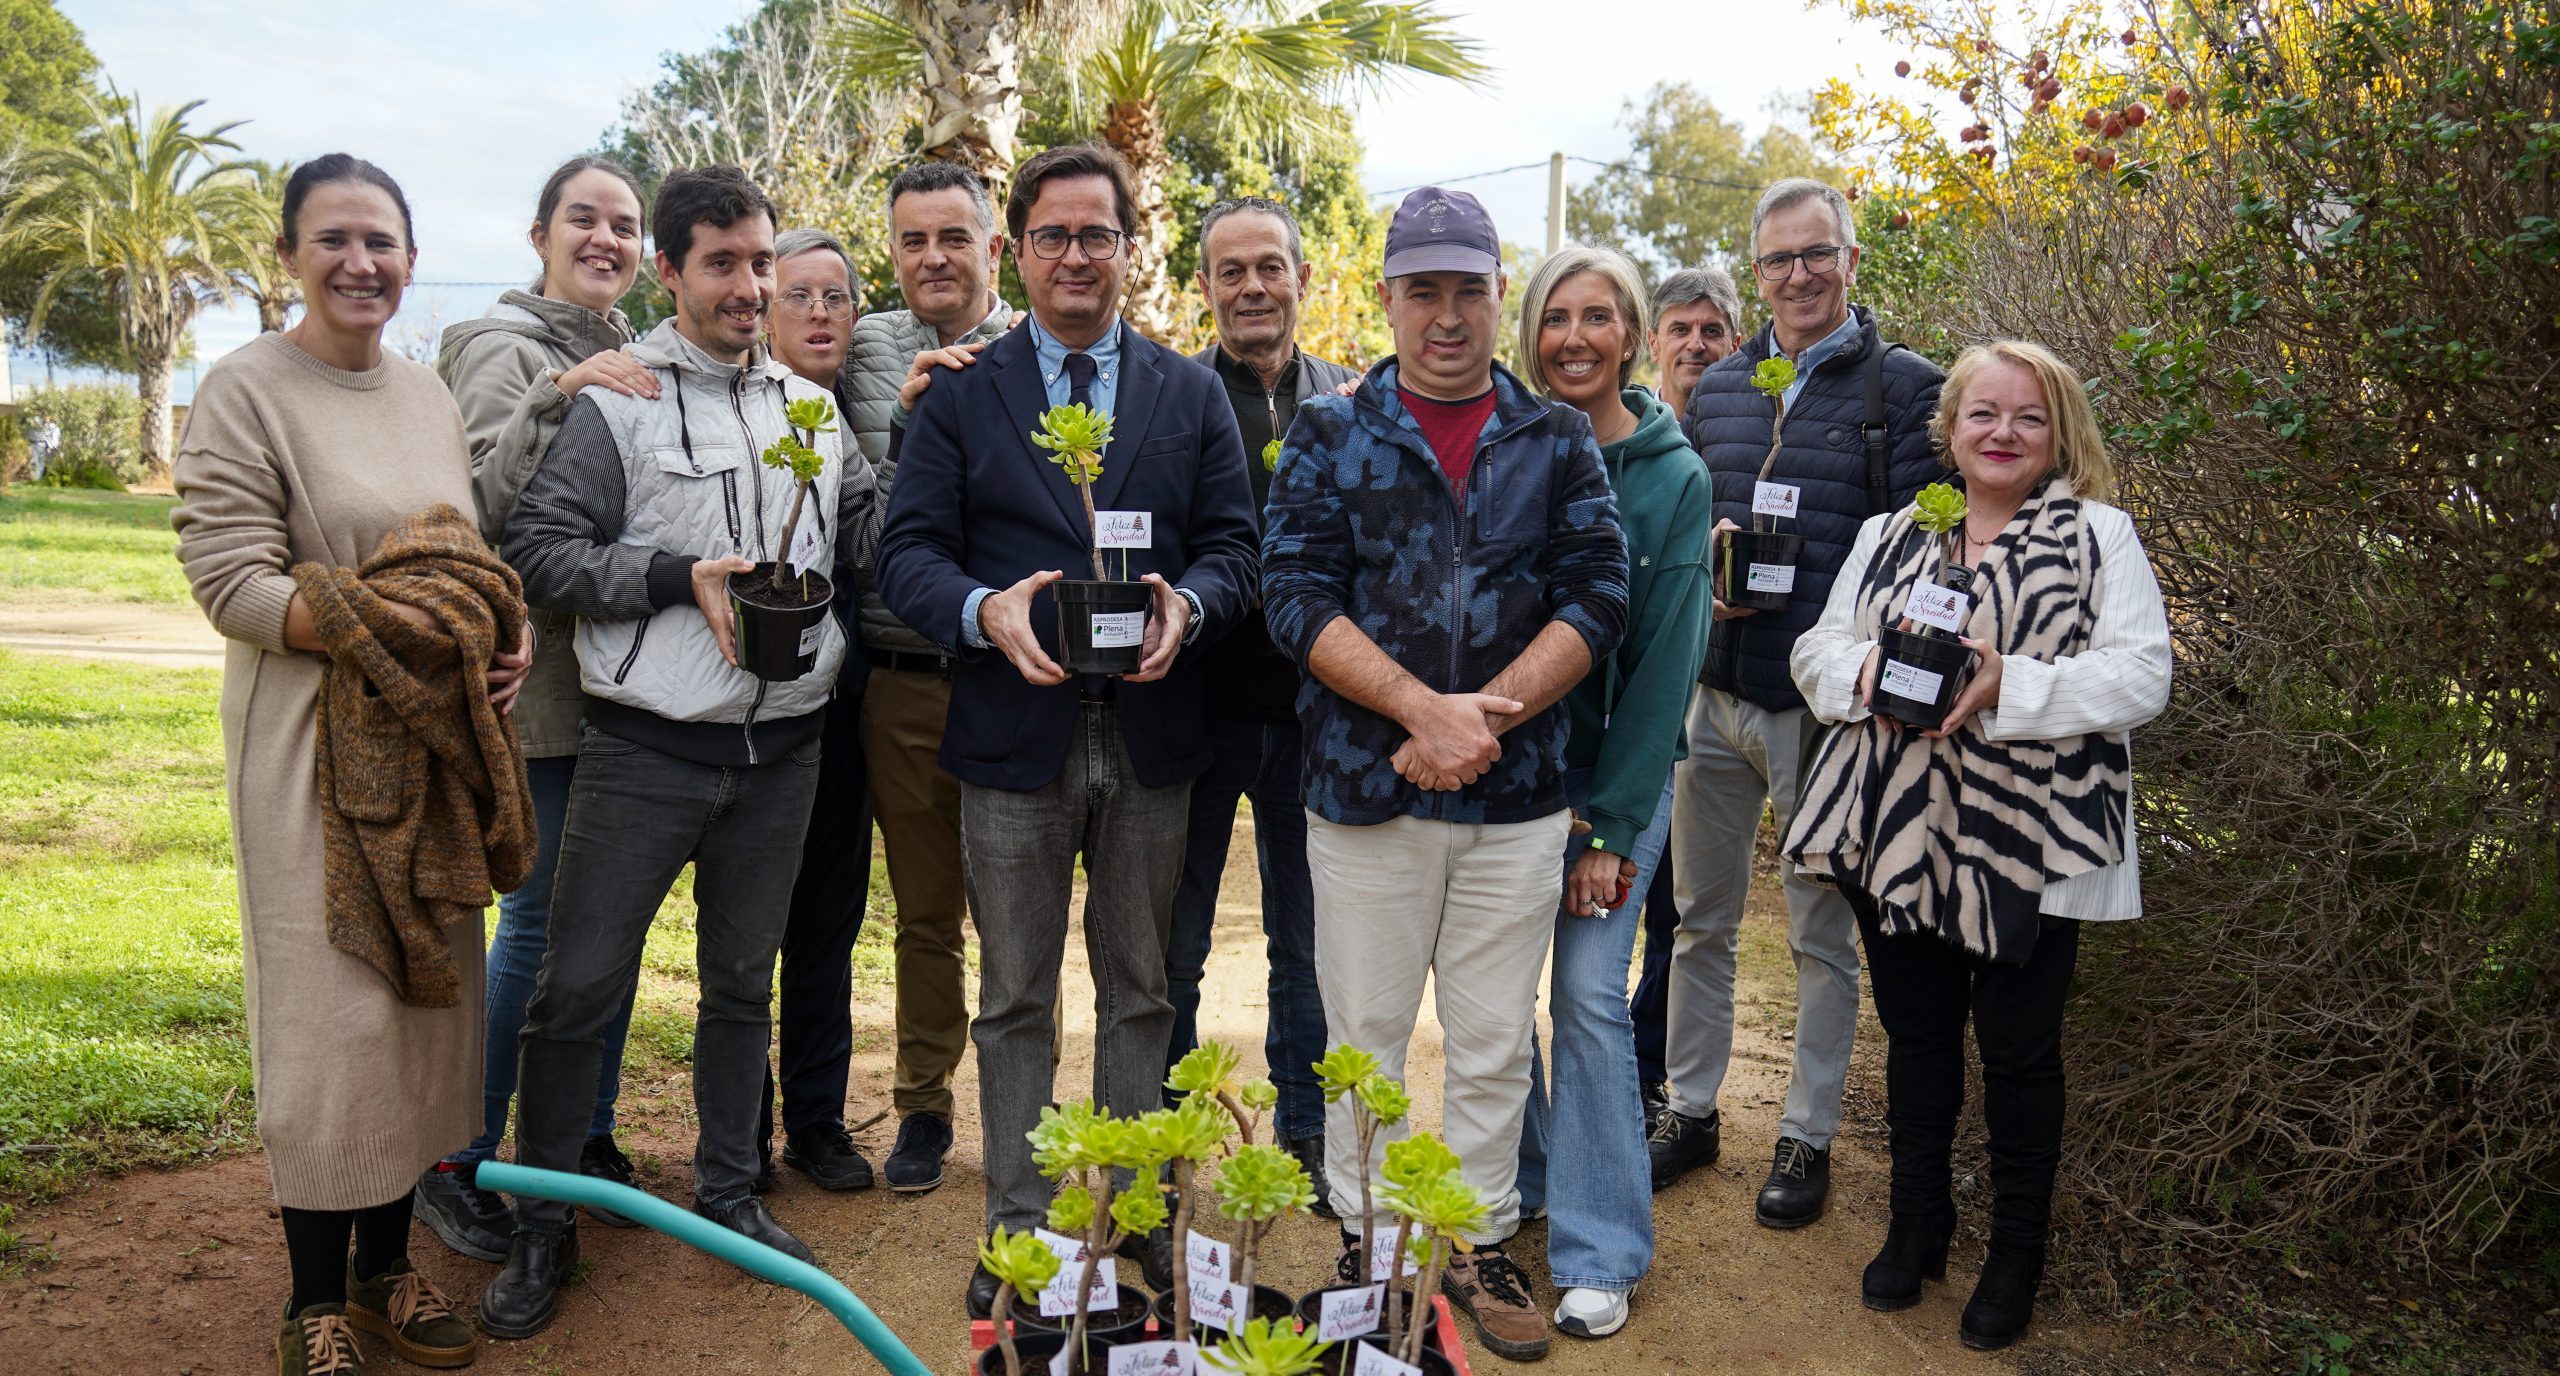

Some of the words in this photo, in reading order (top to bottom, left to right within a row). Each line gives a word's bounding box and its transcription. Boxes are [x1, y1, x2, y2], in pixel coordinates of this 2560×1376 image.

[1760, 487, 1784, 501] Feliz
[1758, 500, 1794, 511] Navidad
[1102, 515, 1131, 531] Feliz
[1101, 530, 1146, 544] Navidad
[1758, 572, 1775, 580] Plena
[1915, 590, 1942, 607] Feliz
[1910, 603, 1957, 621] Navidad
[1892, 672, 1910, 683] Plena
[1373, 1235, 1394, 1257] Feli
[1048, 1271, 1076, 1295] Feli
[1189, 1280, 1217, 1302] Feliz
[1328, 1297, 1362, 1321] Feliz
[1323, 1309, 1376, 1337] Navidad
[1118, 1349, 1158, 1375] Feliz
